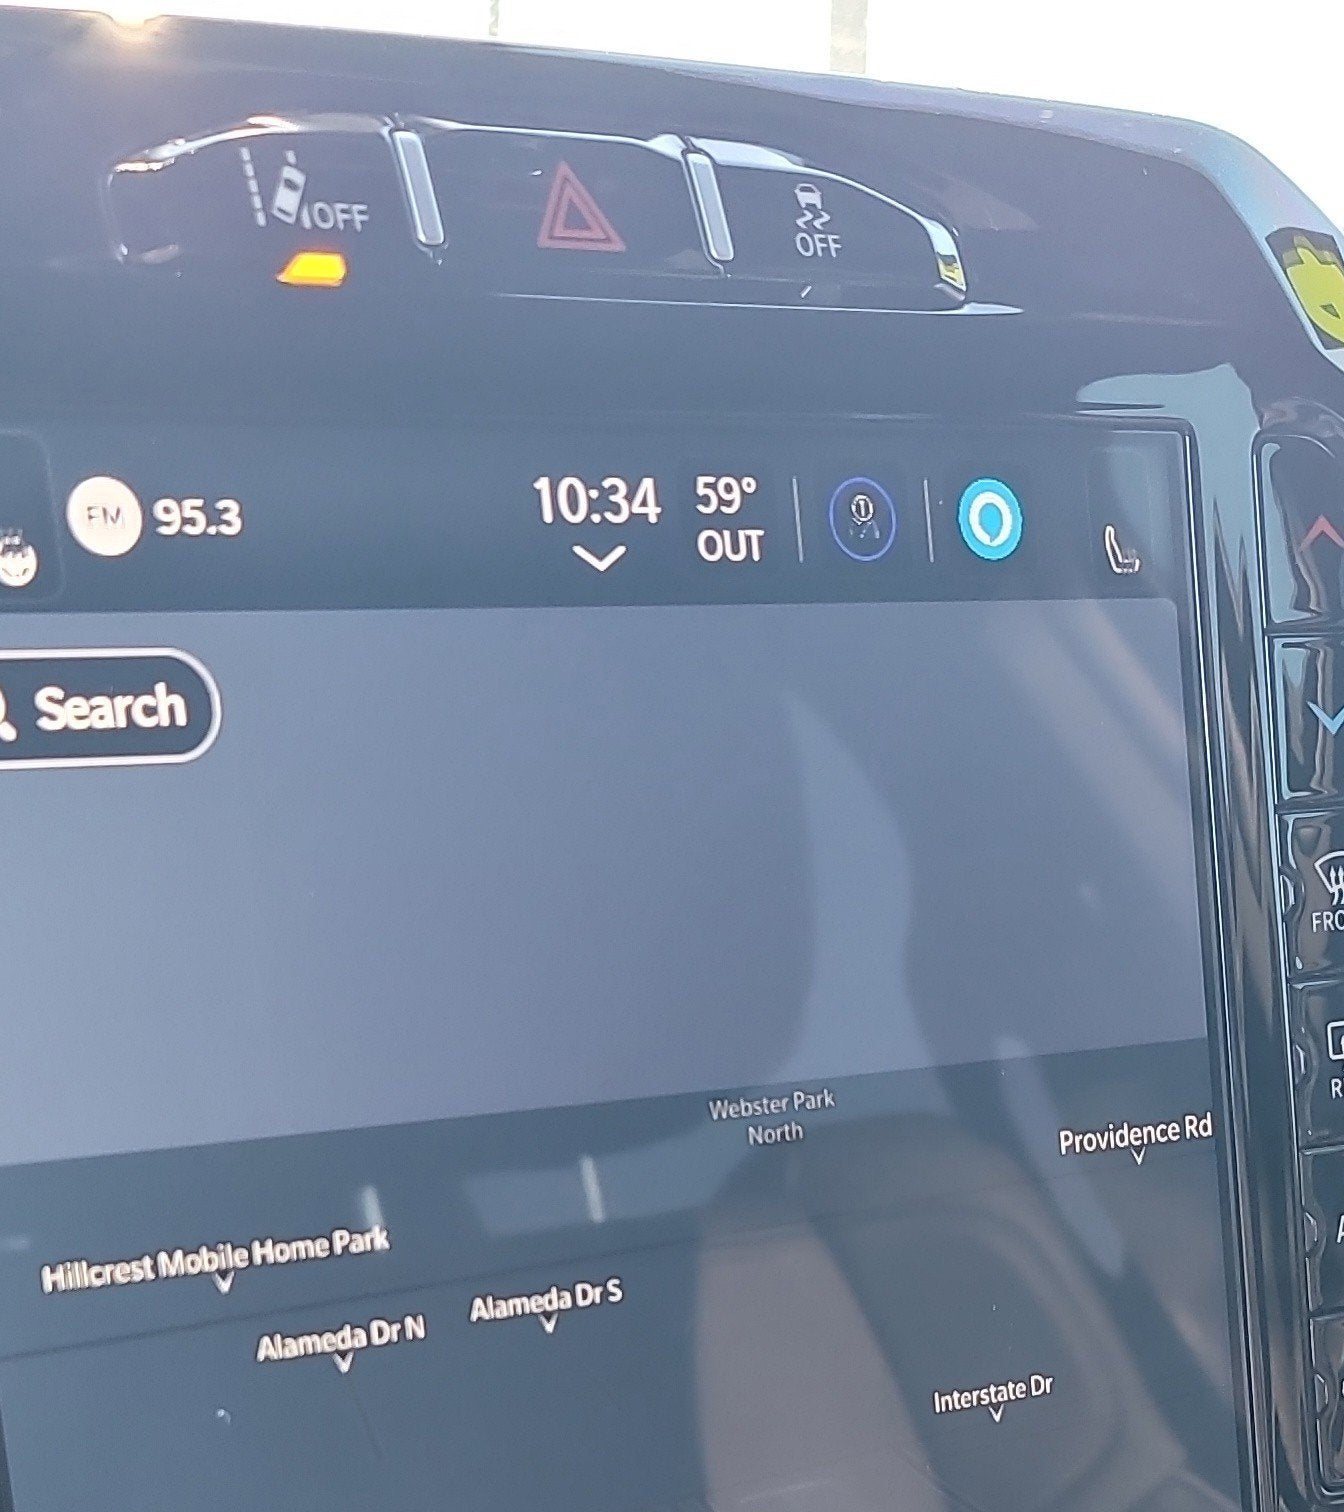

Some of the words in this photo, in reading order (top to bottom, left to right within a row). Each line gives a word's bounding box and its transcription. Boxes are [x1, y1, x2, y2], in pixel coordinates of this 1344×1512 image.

[311, 202, 370, 232] OFF
[794, 231, 843, 259] OFF
[531, 476, 662, 526] 10:34
[694, 476, 758, 515] 59°
[86, 503, 128, 530] FM
[153, 498, 244, 537] 95.3
[696, 529, 765, 562] OUT
[34, 682, 188, 732] Search
[708, 1094, 790, 1122] Webster
[792, 1087, 837, 1111] Park
[747, 1121, 805, 1147] North
[1059, 1119, 1181, 1156] Providence
[1184, 1111, 1214, 1139] Rd
[40, 1255, 155, 1295] Hillcrest
[156, 1241, 249, 1278] Mobile
[250, 1231, 331, 1267] Home
[331, 1224, 392, 1256] Park
[469, 1285, 572, 1322] Alameda
[574, 1282, 605, 1310] Dr
[606, 1278, 623, 1303] S
[256, 1321, 368, 1363] Alameda
[369, 1318, 402, 1347] Dr
[404, 1314, 427, 1341] N
[933, 1379, 1027, 1414] Interstate
[1029, 1374, 1054, 1397] Dr
